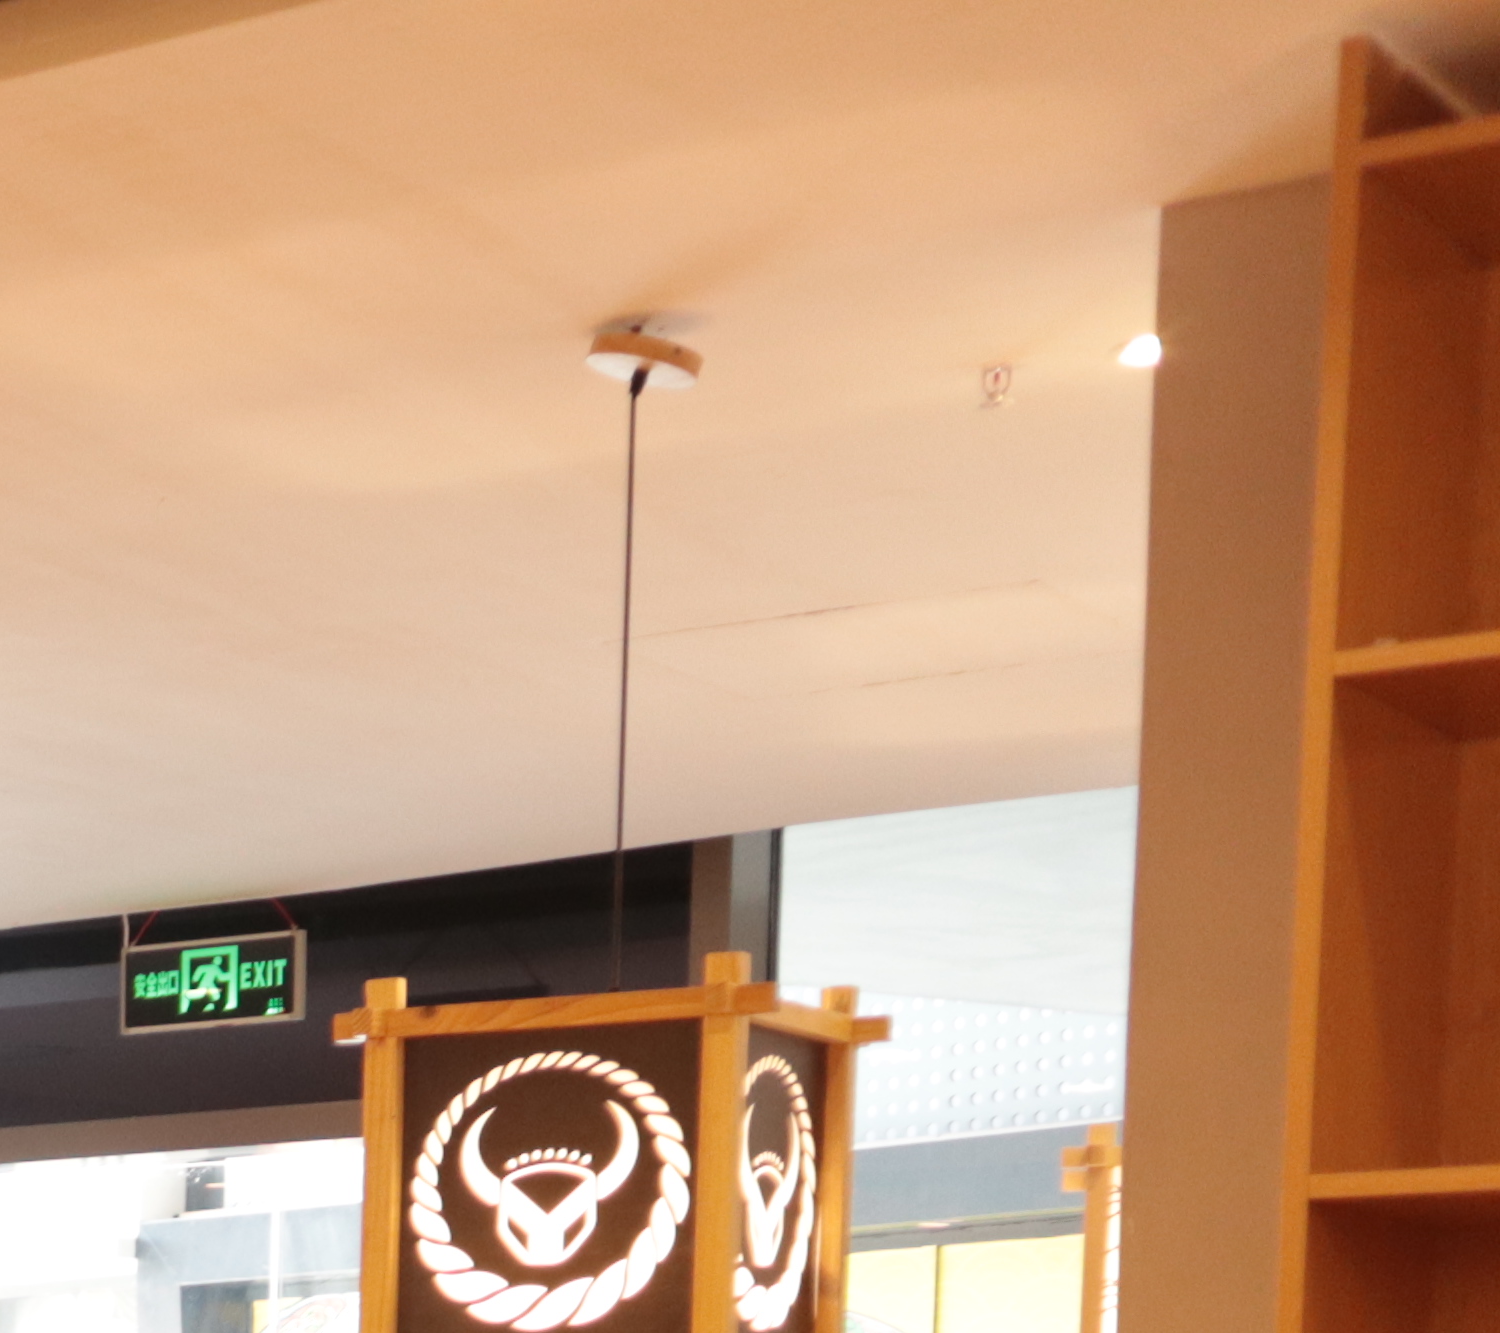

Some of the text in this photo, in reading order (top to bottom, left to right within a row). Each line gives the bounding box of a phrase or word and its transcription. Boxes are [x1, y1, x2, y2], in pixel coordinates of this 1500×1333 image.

[134, 970, 179, 999] 安全出口
[240, 958, 288, 990] EXIT
